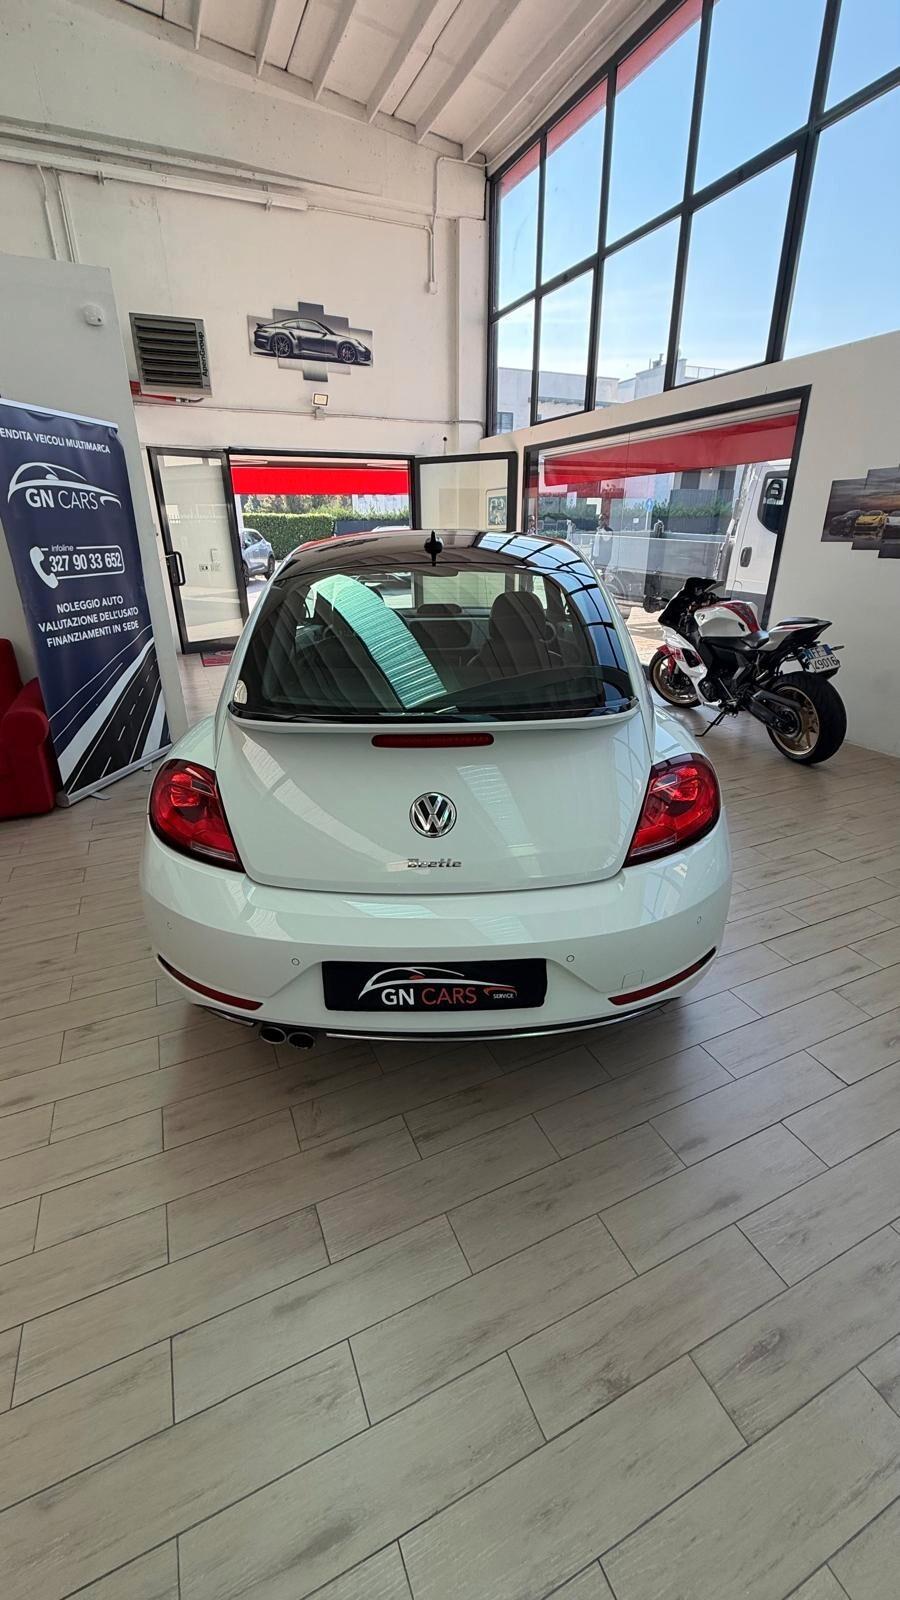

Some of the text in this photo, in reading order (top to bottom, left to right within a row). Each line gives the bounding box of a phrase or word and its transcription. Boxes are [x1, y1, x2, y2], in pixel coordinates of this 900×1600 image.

[0, 427, 111, 454] ENDITA VEICOLI MULTIMARCA
[25, 488, 98, 510] GN CARS
[49, 552, 122, 572] 327 90 33 652
[56, 595, 124, 614] NOLEGGIO AUTO
[38, 613, 99, 633] VALUTAZIONE
[46, 620, 139, 648] FINANZIAMENTI IN SEDE
[407, 858, 462, 868] Beetle
[381, 987, 477, 1005] GN CARS
